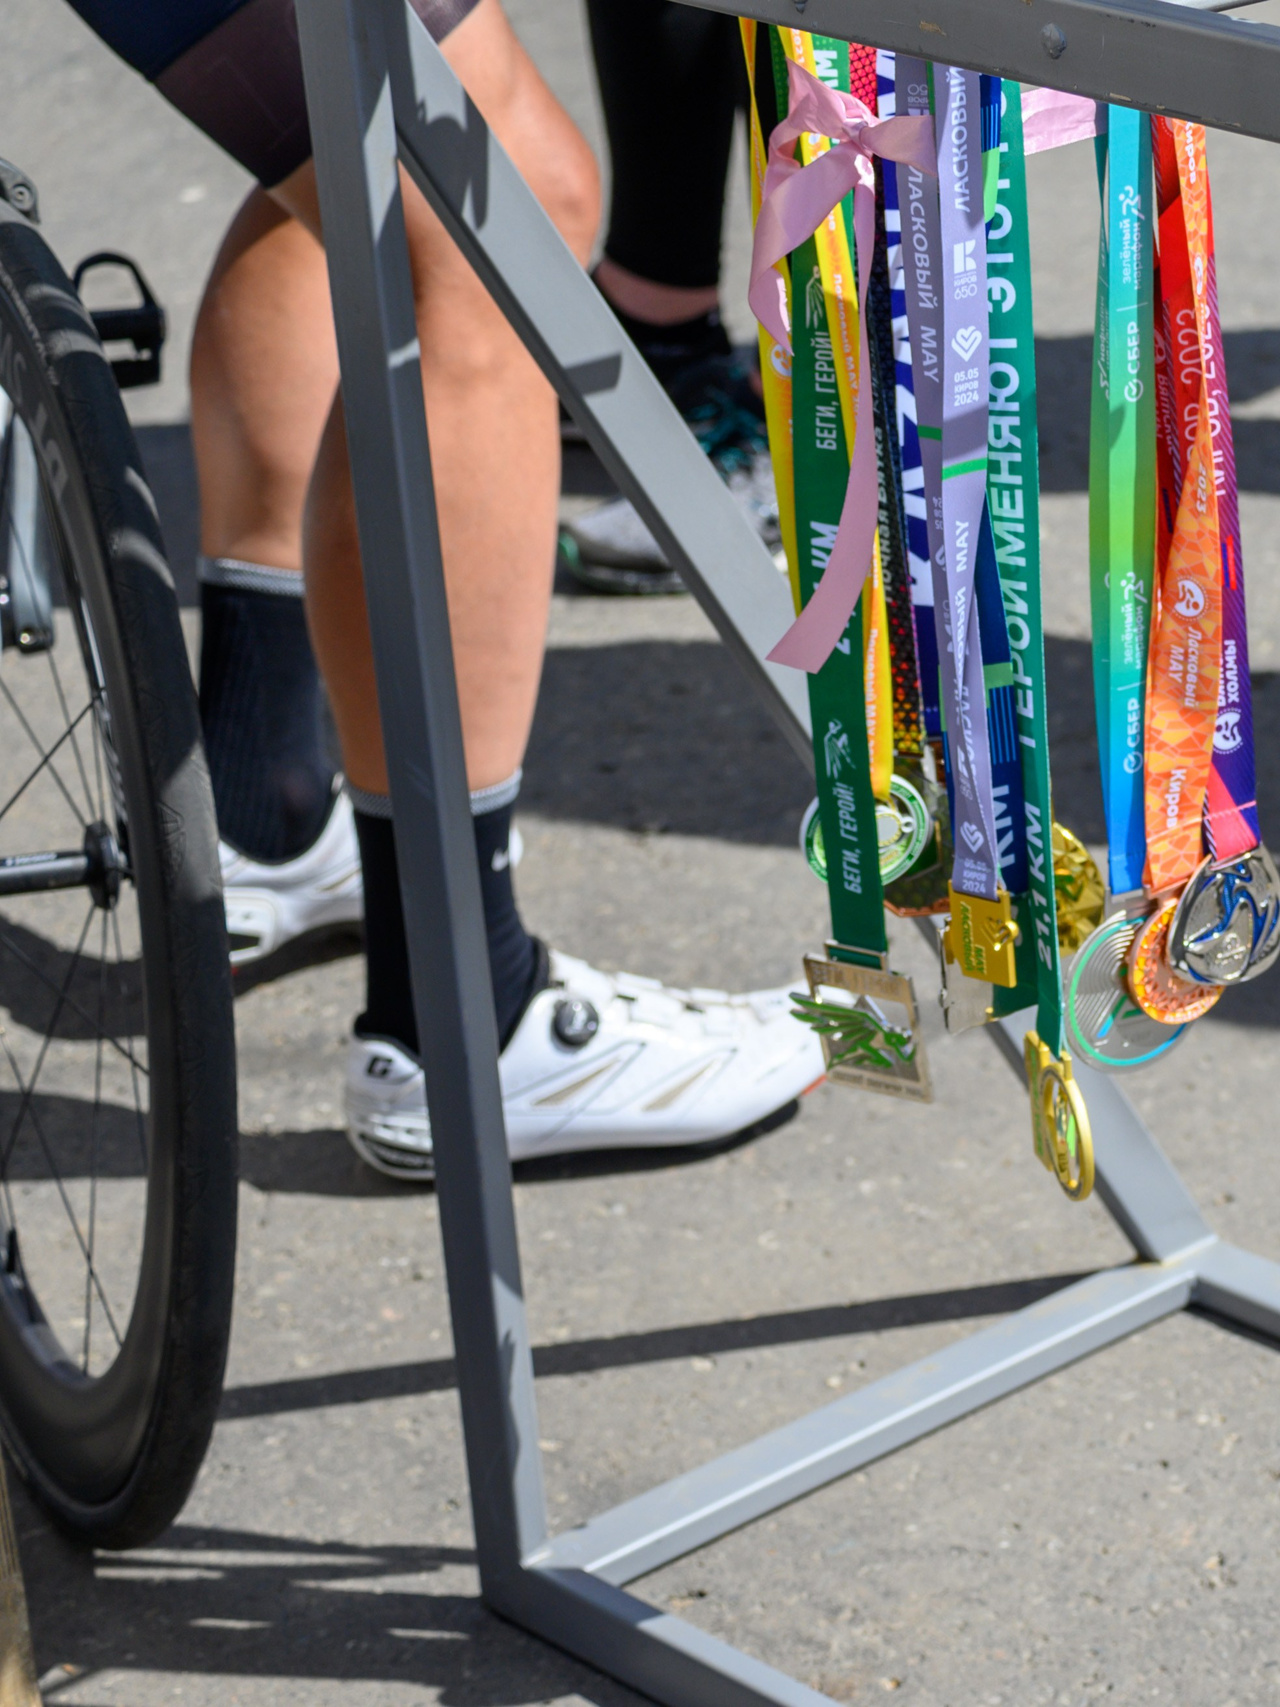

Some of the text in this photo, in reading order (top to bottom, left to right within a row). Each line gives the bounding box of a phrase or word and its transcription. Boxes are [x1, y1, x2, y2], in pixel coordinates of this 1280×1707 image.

[945, 65, 971, 213] ЛАСКОВЫЙ
[907, 163, 939, 310] ЛАСКОВЫЙ
[1119, 219, 1132, 284] зелёный
[1133, 222, 1143, 290] марафон
[953, 275, 978, 287] КИРОВ
[953, 283, 979, 301] 650
[953, 367, 980, 383] 05.05
[1127, 321, 1141, 374] СБЕР
[810, 331, 839, 451] БЕГИ, ГЕРОЙ!
[953, 380, 980, 394] КИРОВ
[953, 390, 980, 408] 2024
[1121, 602, 1133, 665] зелёный
[1168, 644, 1185, 684] MAY
[1184, 626, 1203, 708] Ласковый
[1127, 698, 1141, 748] СБЕР
[1165, 768, 1187, 829] Киров
[832, 782, 863, 895] БЕГИ, ГЕРОЙ!
[962, 880, 987, 894] 2024
